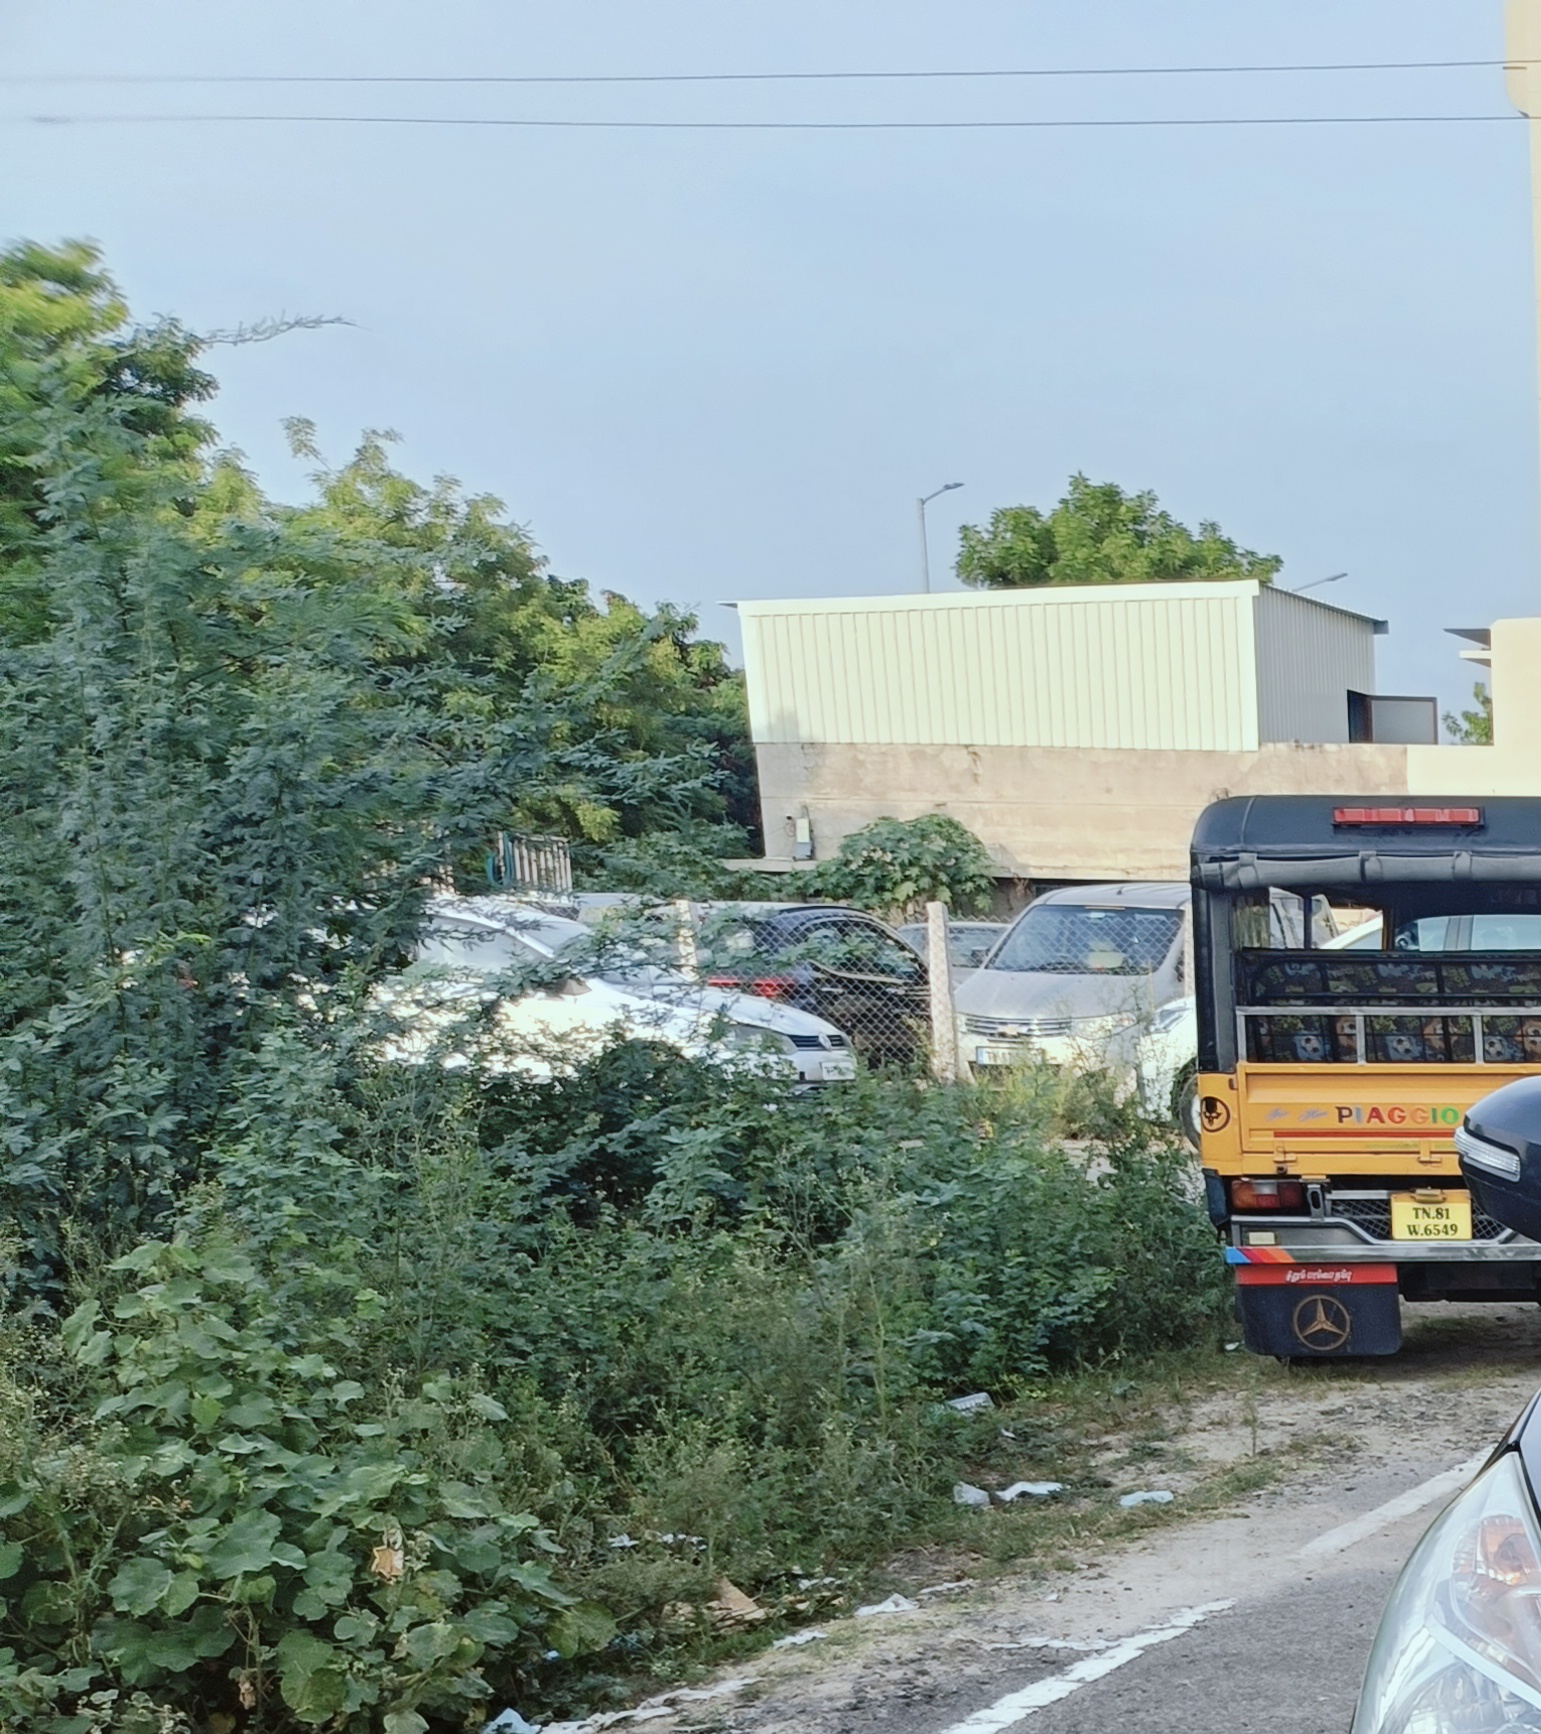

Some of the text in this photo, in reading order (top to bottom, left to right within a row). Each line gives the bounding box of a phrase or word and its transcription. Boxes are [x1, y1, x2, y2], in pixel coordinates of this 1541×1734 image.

[1335, 1106, 1460, 1125] PIAGGIO
[1412, 1207, 1451, 1220] TN.81
[1406, 1223, 1459, 1237] W.6549
